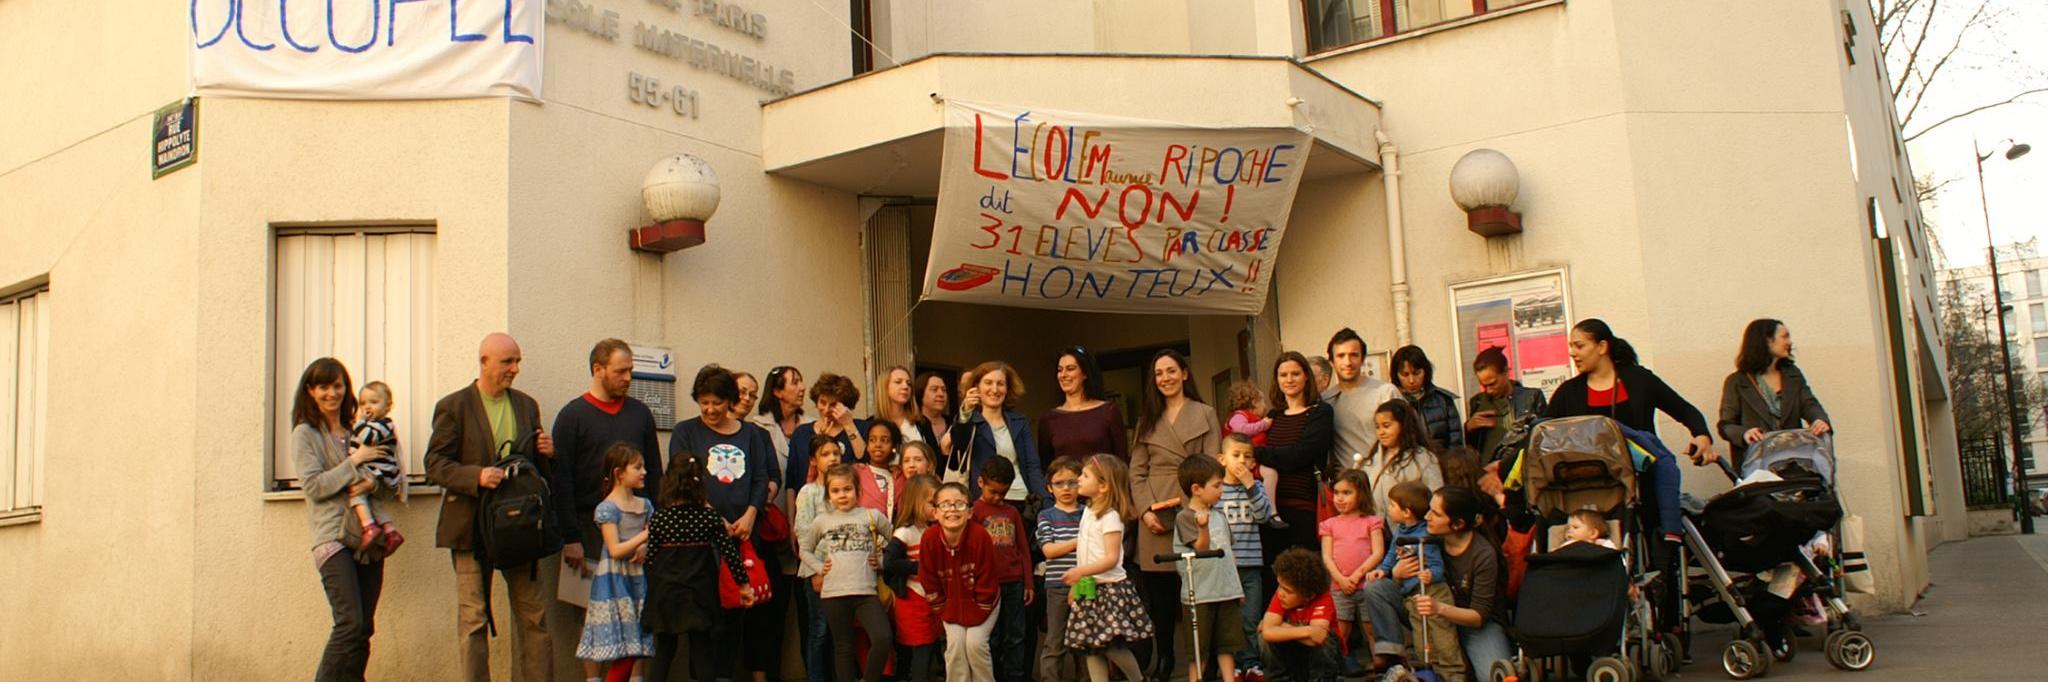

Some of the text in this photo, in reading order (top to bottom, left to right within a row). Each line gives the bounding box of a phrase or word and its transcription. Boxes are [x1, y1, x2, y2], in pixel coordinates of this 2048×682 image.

[632, 20, 795, 96] MATERNELLE
[157, 129, 191, 153] HIPPOLYTE
[168, 120, 181, 136] RUE
[979, 186, 1014, 214] dit
[1055, 184, 1201, 230] NON
[970, 212, 1024, 256] 31
[1163, 227, 1200, 264] PAR
[1206, 228, 1277, 253] CLASSE
[1001, 258, 1235, 301] HONTEUX
[1541, 375, 1566, 386] avril
